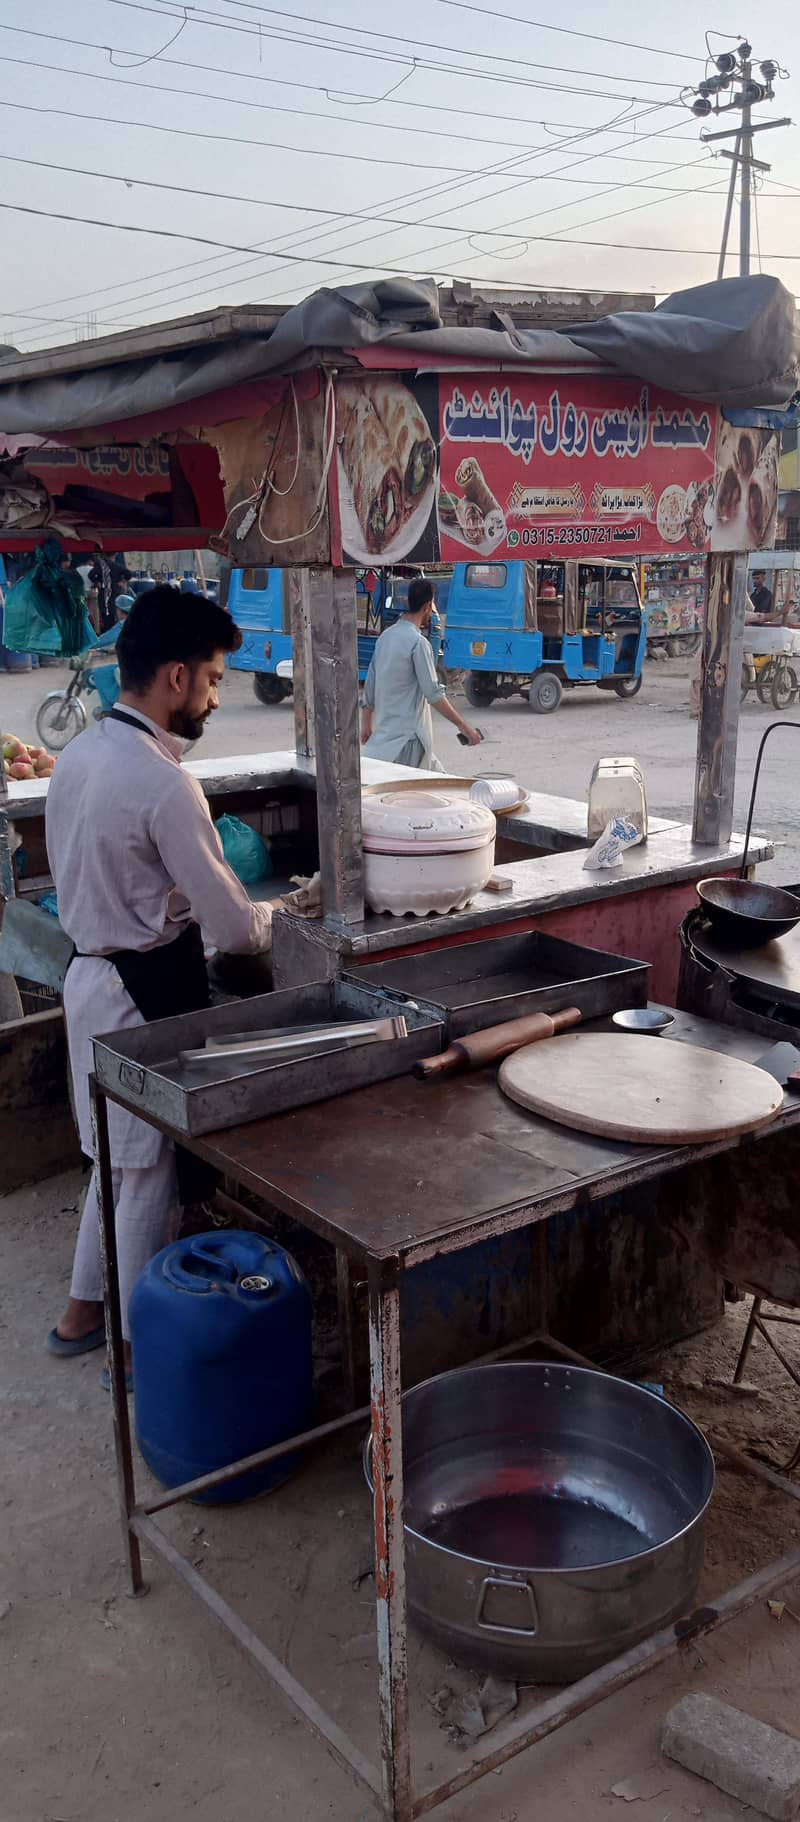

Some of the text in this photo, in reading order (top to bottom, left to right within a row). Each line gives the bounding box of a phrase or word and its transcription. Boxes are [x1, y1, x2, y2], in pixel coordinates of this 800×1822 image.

[444, 387, 538, 465] پوائنٹ
[541, 391, 589, 458] رول
[651, 406, 711, 450] محمد
[522, 525, 641, 545] احمد 0315-2350721
